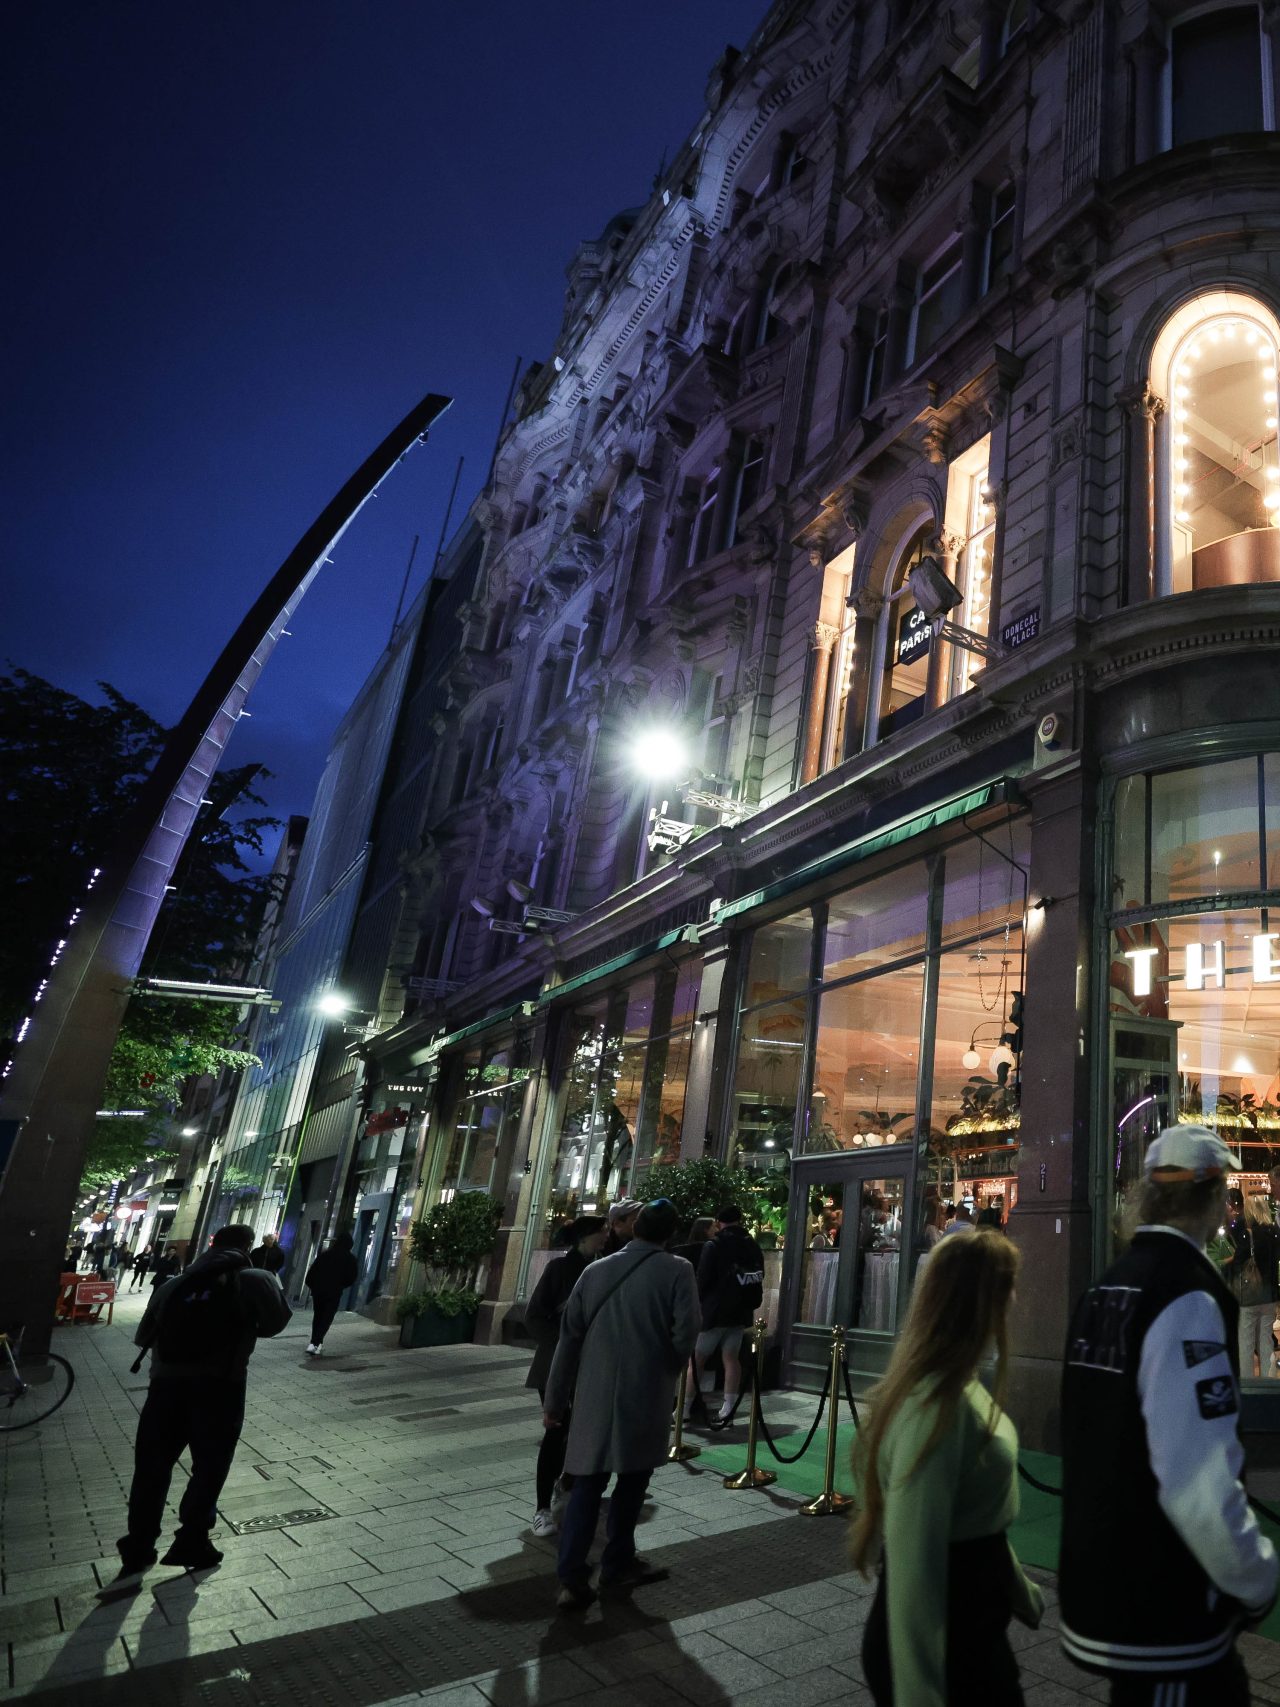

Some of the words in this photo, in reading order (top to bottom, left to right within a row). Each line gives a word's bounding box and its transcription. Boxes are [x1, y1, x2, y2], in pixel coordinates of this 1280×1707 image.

[909, 610, 926, 629] CA
[1011, 624, 1037, 647] PLACE
[387, 1084, 404, 1092] THE
[407, 1085, 424, 1093] IVY
[441, 1189, 455, 1204] TH
